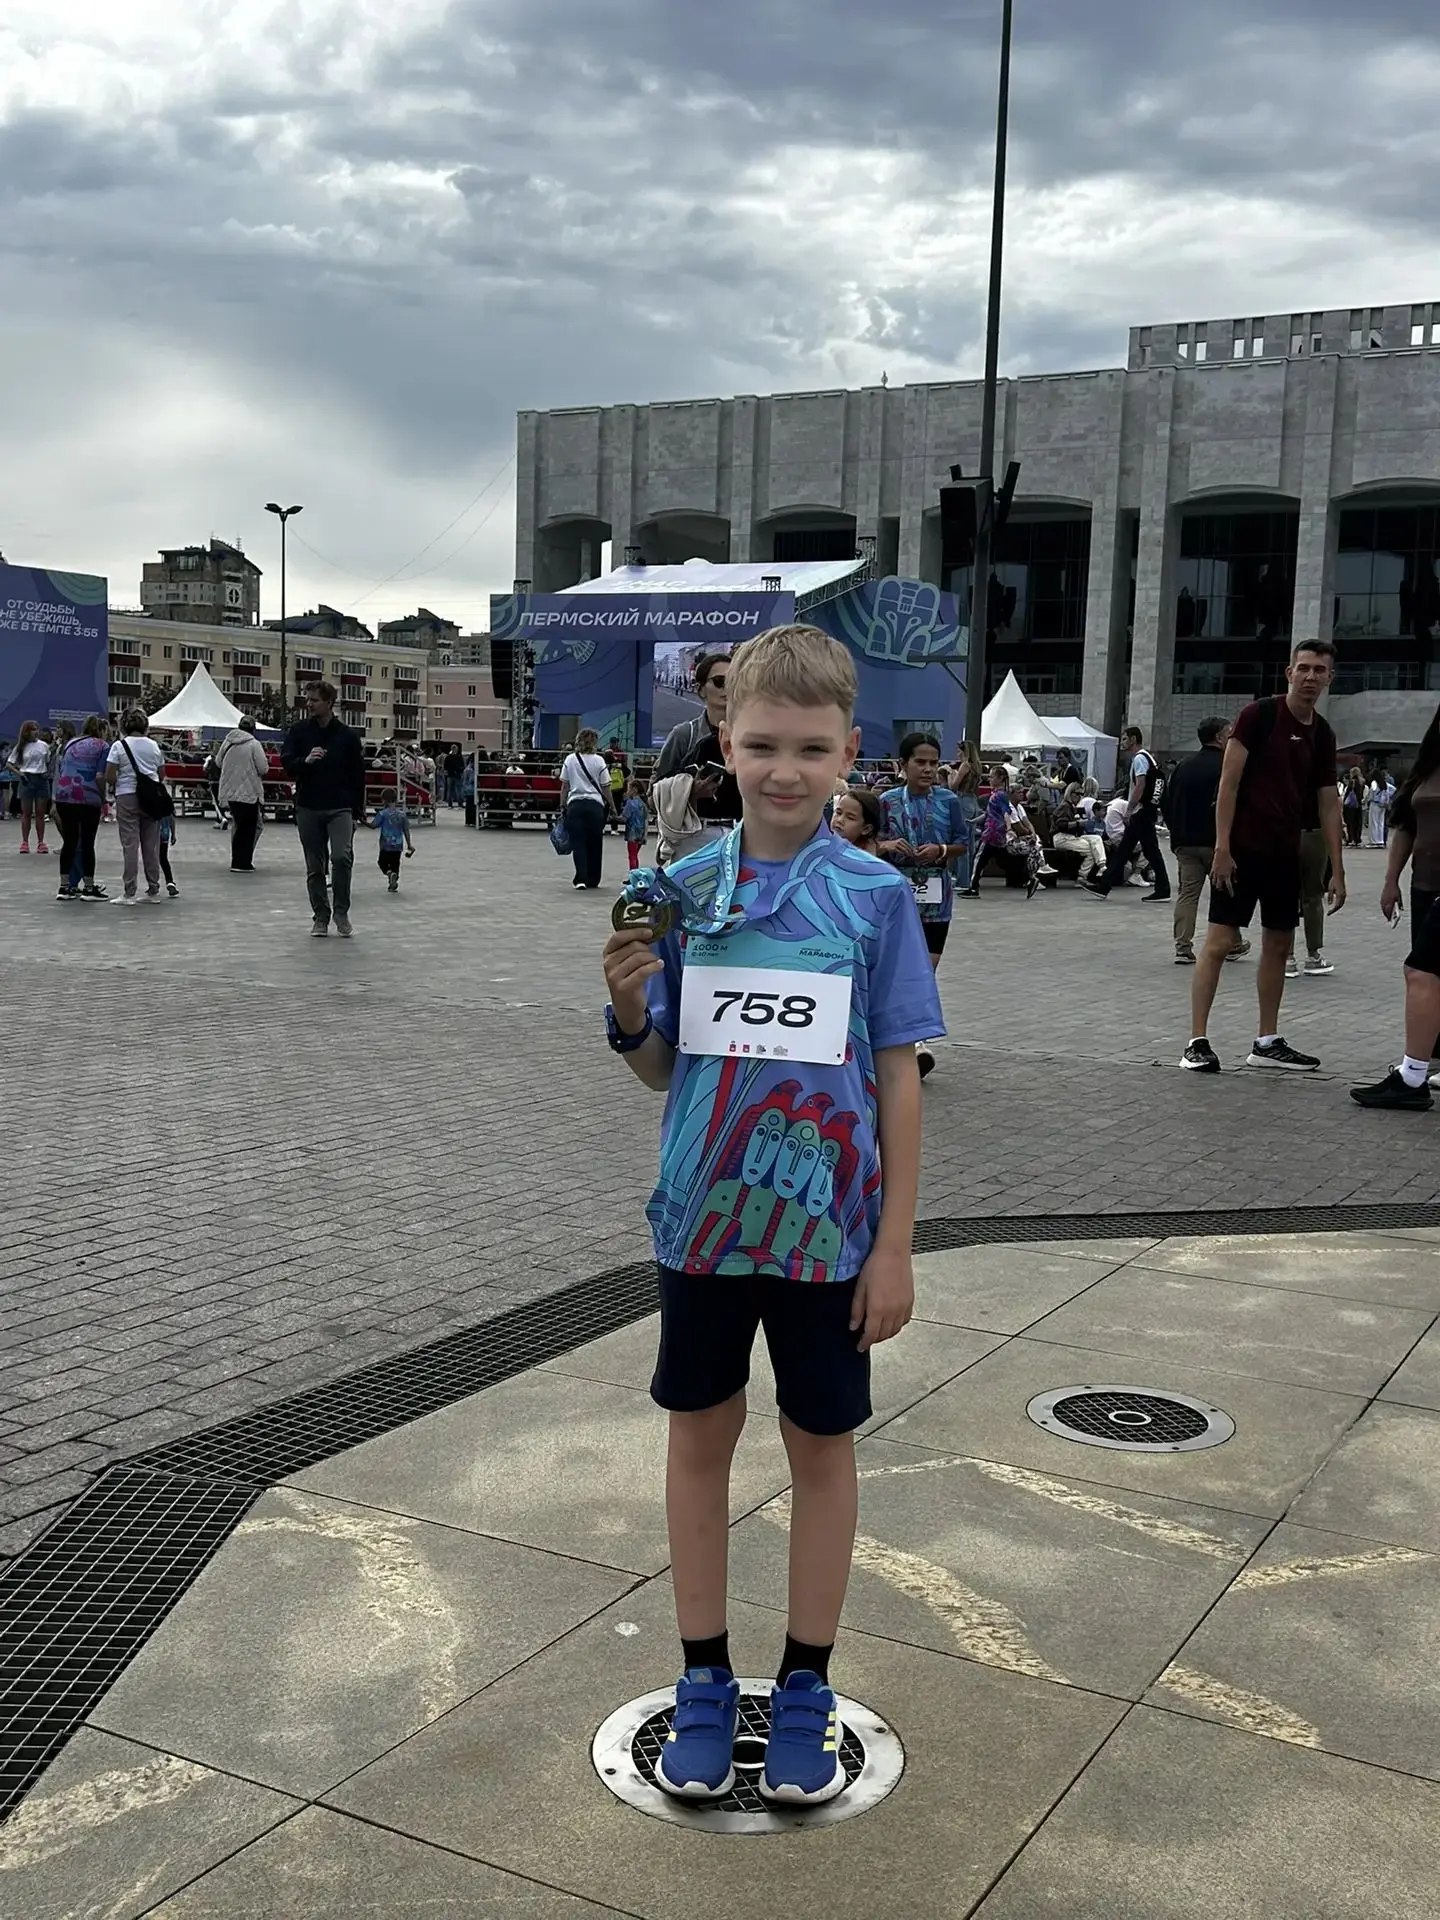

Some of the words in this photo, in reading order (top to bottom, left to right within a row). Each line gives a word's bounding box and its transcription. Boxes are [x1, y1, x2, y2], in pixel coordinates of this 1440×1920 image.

[7, 599, 24, 609] ОТ
[25, 601, 76, 615] СУДЬБЫ
[19, 611, 82, 627] УБЕЖИШЬ,
[519, 607, 641, 627] ПЕРМСКИЙ
[643, 610, 760, 627] МАРАФОН
[21, 621, 29, 631] В
[31, 622, 71, 636] ТЕМПЕ
[73, 626, 99, 638] 3:55
[692, 943, 720, 952] 1000
[799, 949, 845, 960] МАРАФОН
[712, 990, 817, 1028] 758
